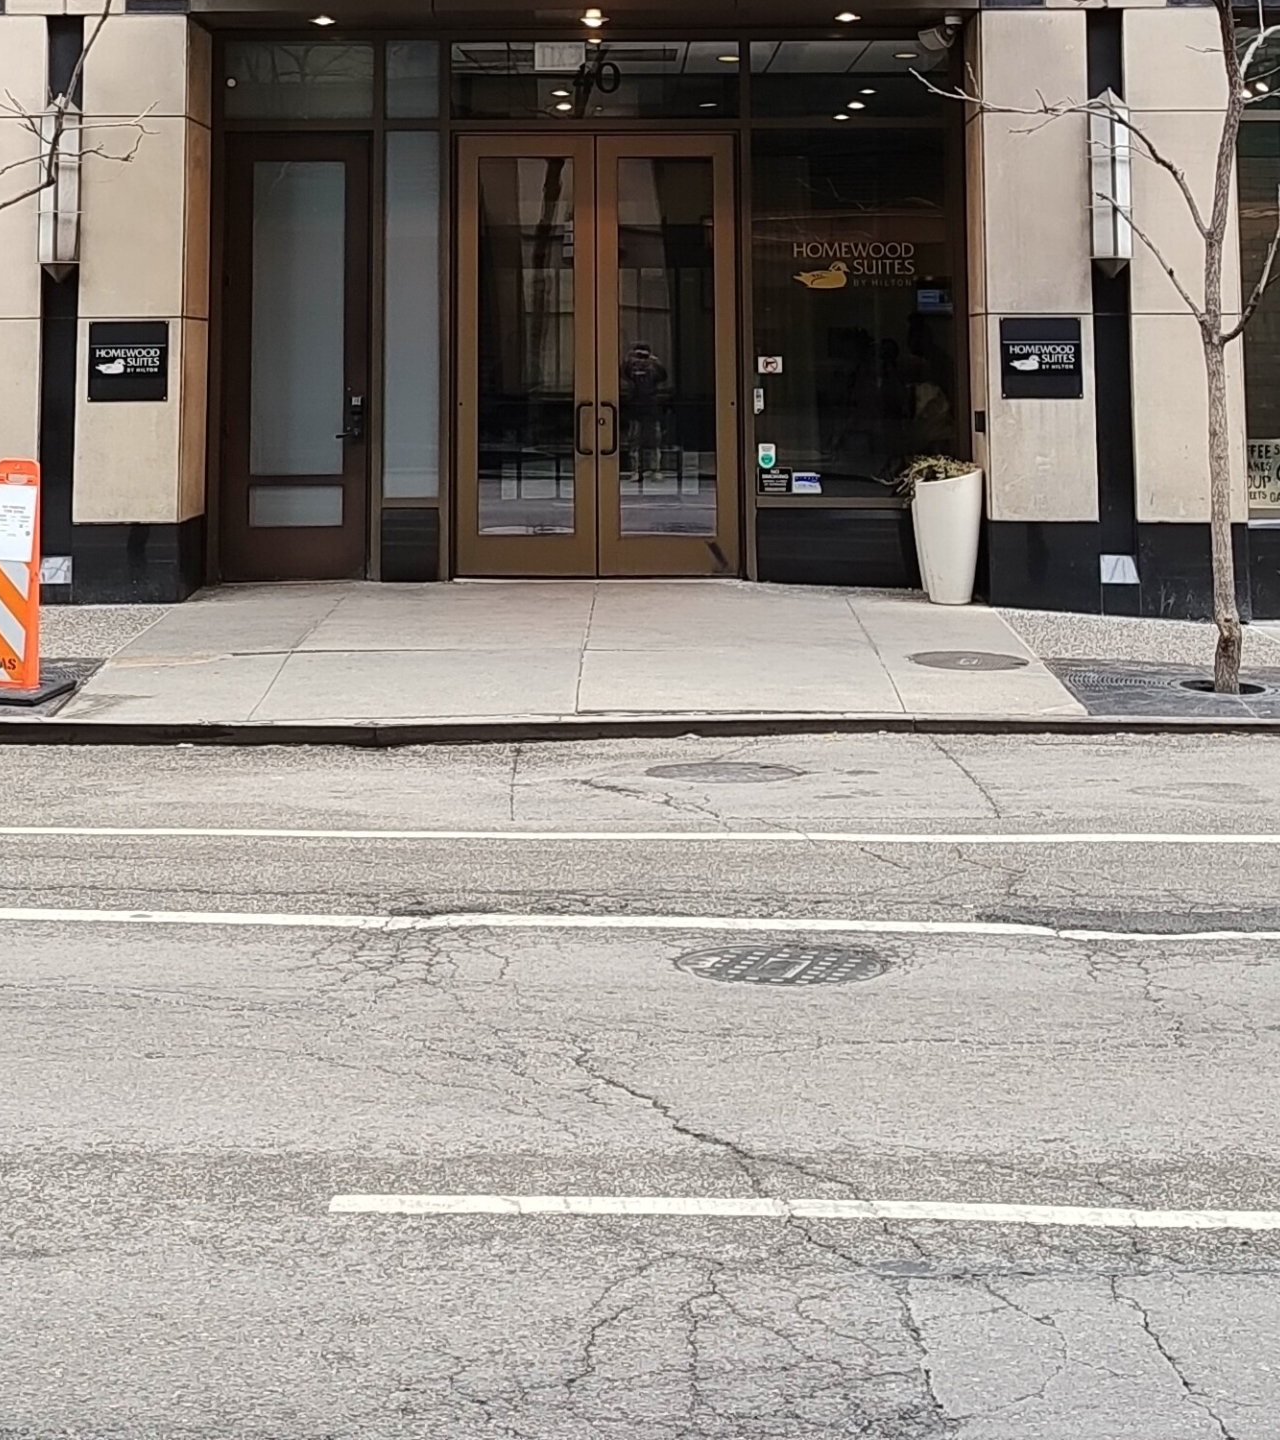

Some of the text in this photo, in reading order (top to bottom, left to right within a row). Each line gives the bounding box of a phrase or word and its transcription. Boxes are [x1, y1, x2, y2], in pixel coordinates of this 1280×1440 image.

[793, 242, 914, 258] HOMEWOOD
[853, 259, 915, 276] SUITES
[853, 278, 913, 288] BY HILTON
[95, 348, 160, 358] HOMEWOOD
[1009, 345, 1075, 354] HOMEWOOD
[126, 357, 160, 366] SUITES
[1041, 354, 1076, 363] SUITES
